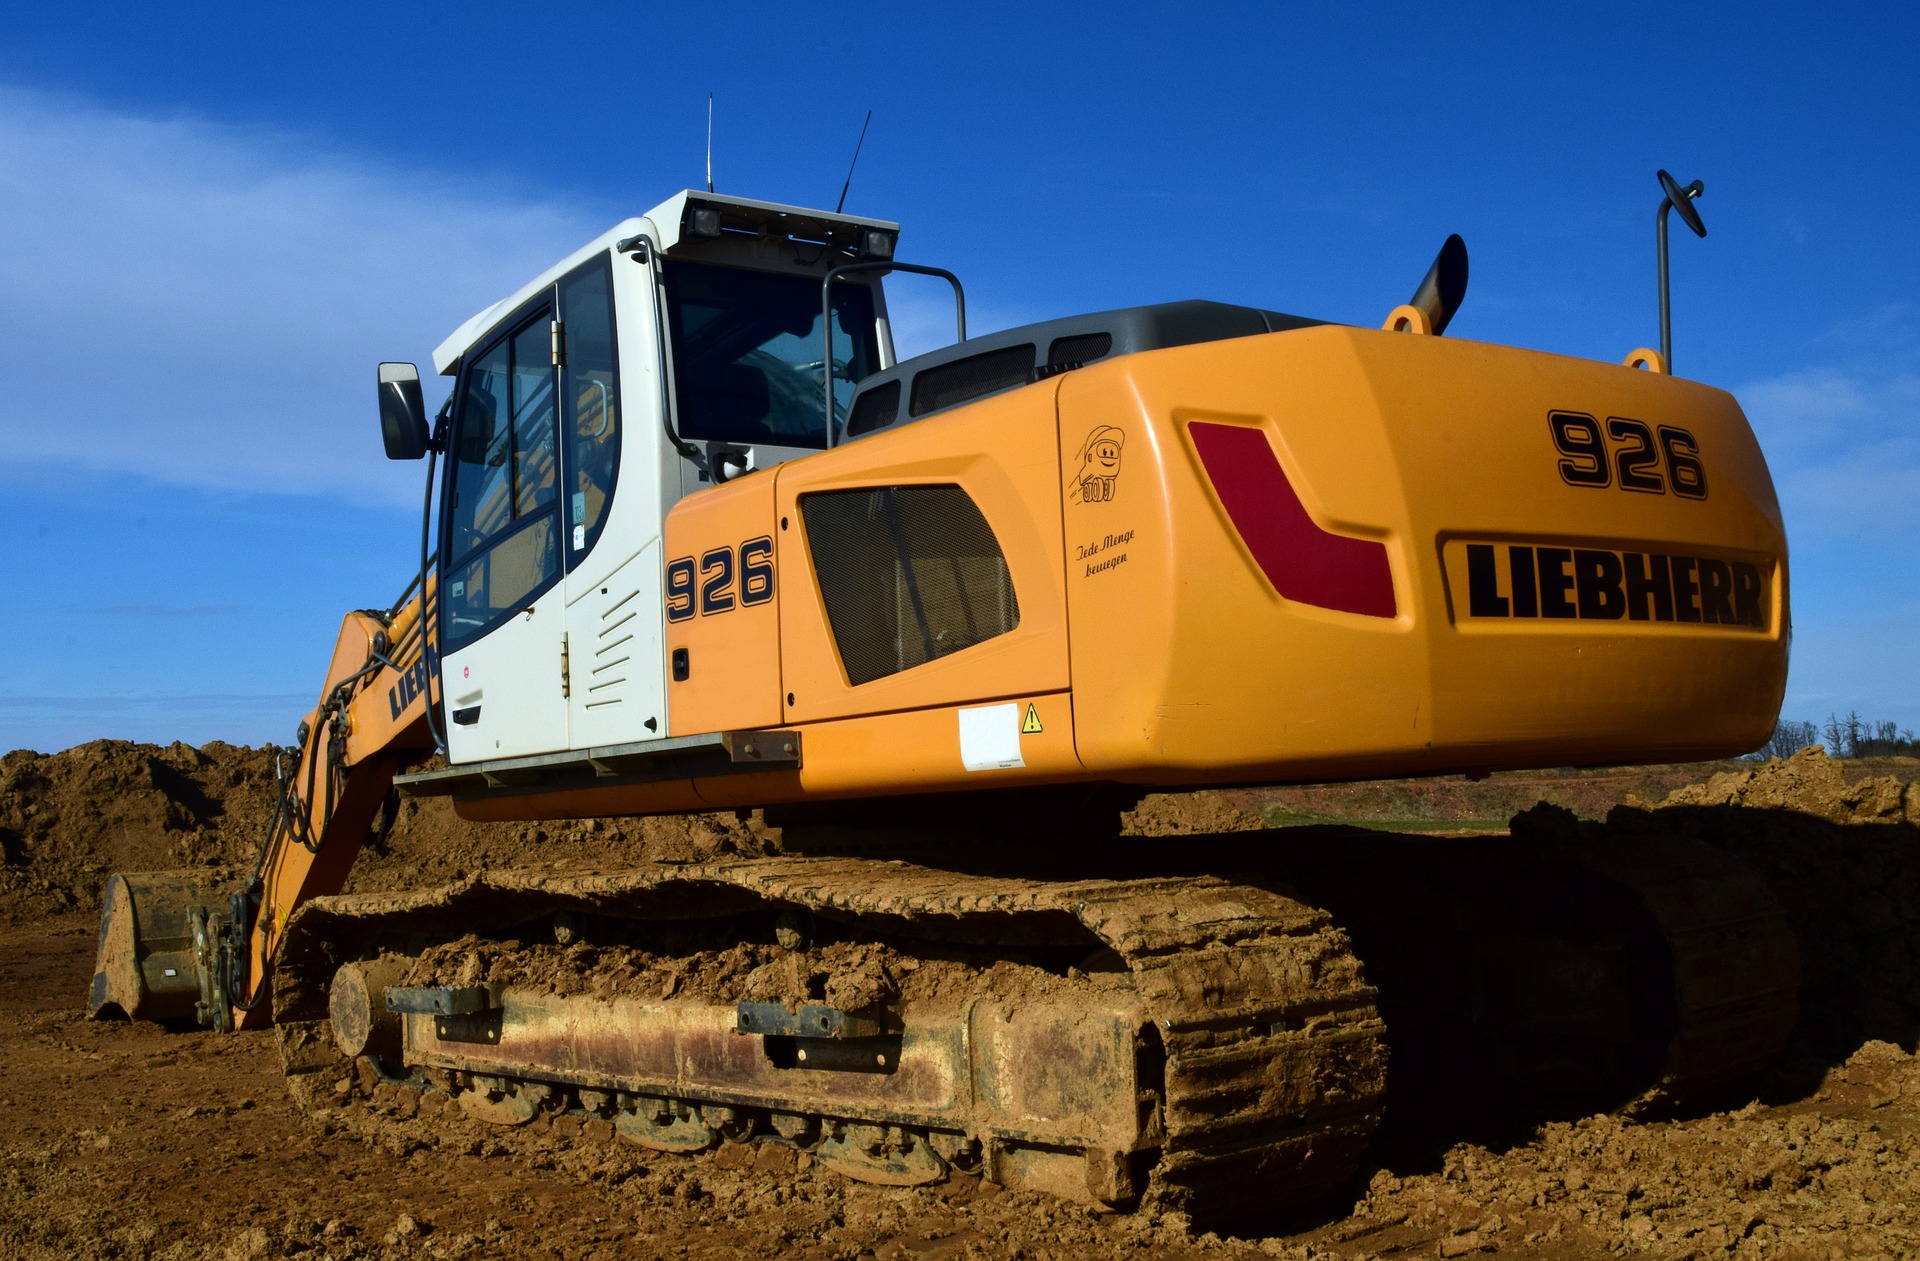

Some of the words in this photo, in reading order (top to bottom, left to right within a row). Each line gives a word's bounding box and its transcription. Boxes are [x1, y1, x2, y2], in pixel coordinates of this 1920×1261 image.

[1547, 409, 1709, 501] 926
[666, 534, 776, 624] 926
[1084, 553, 1127, 578] bewegen
[1099, 529, 1135, 551] Menge
[1466, 544, 1765, 628] LIEBHERR
